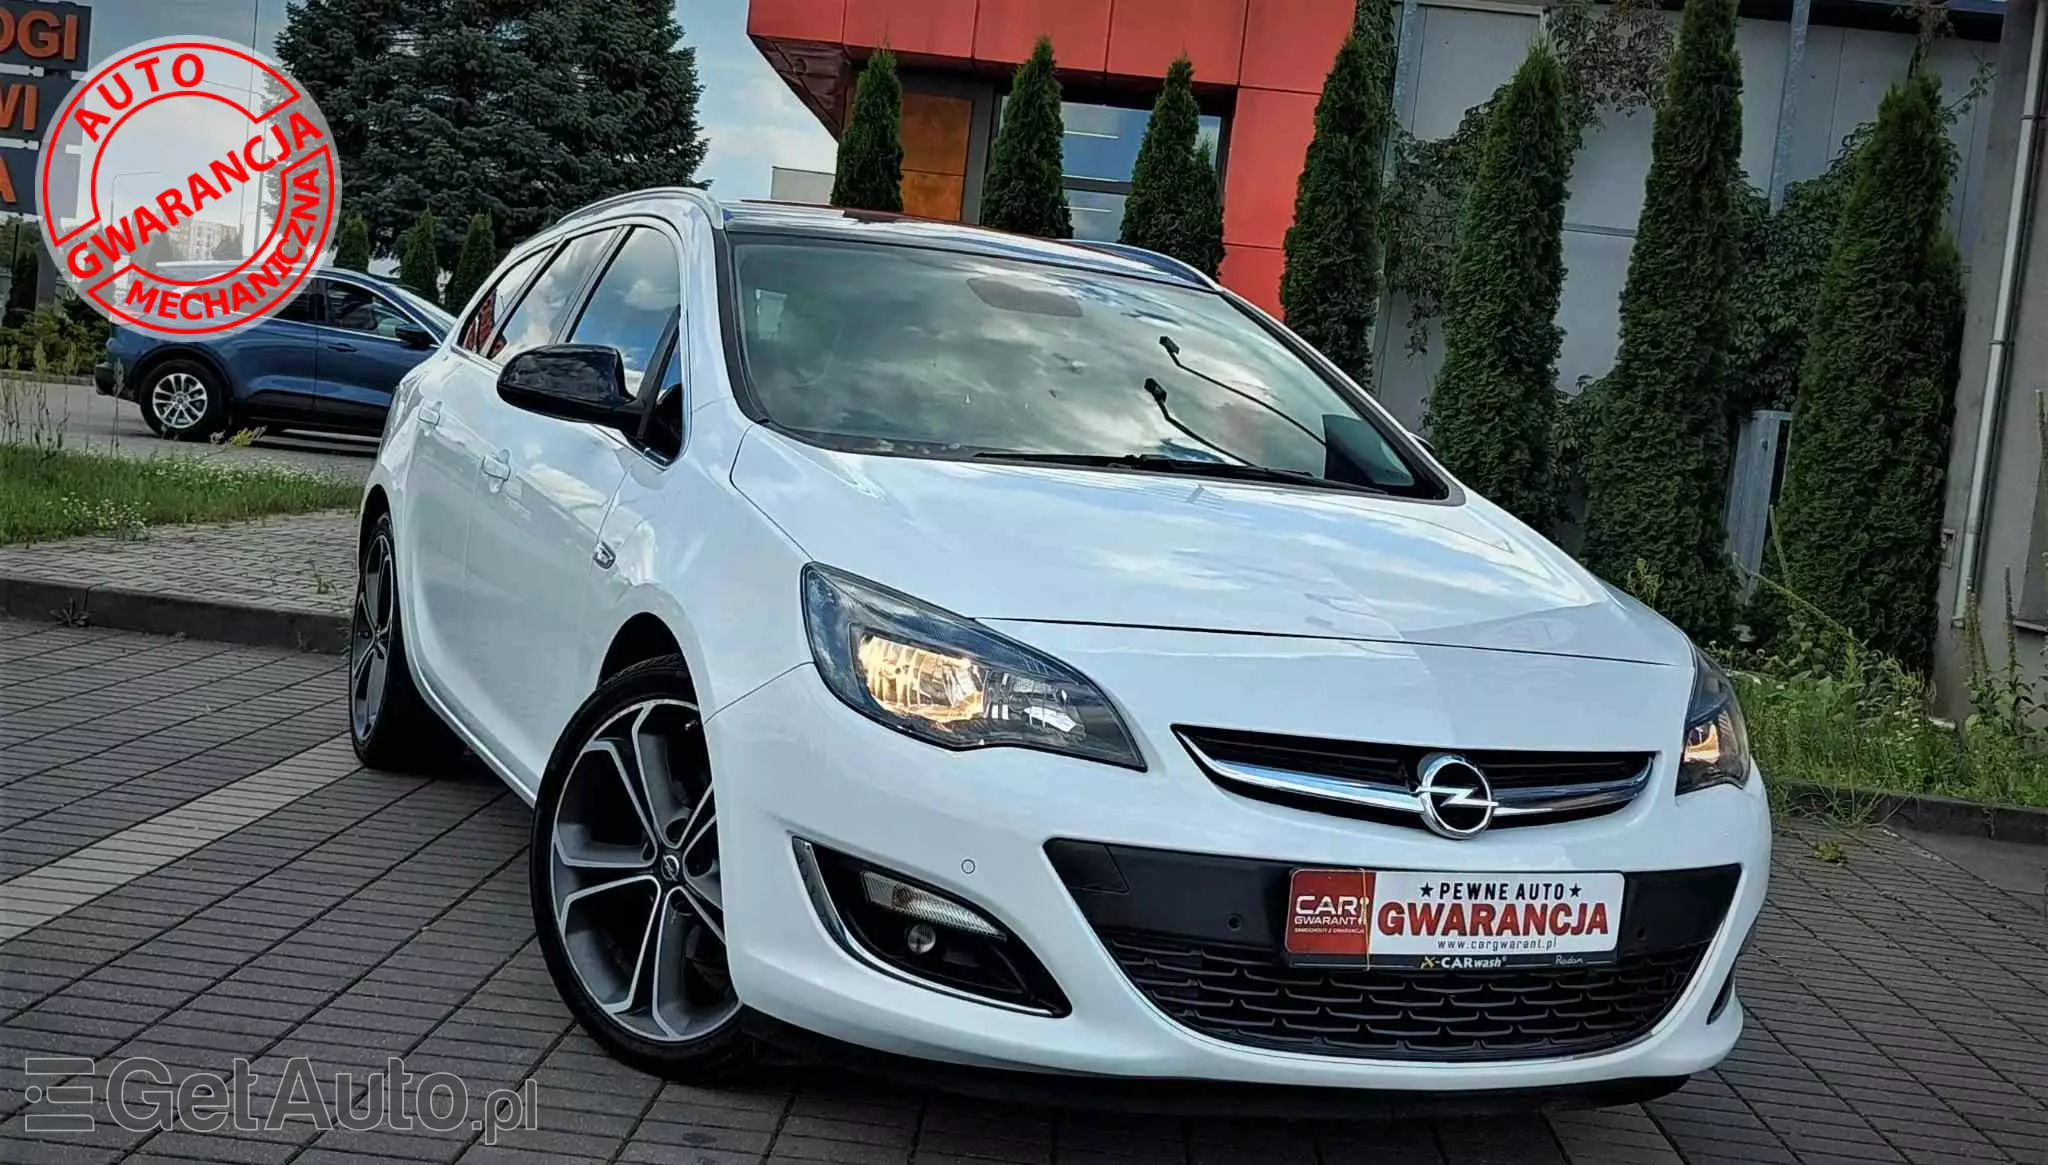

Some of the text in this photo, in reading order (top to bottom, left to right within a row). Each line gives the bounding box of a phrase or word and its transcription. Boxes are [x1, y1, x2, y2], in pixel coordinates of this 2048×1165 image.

[1439, 882, 1565, 900] PEWNE AUTO
[1294, 916, 1357, 925] GWARANT
[1377, 902, 1609, 936] GWARANCJA
[1437, 937, 1557, 951] www.cargwarant.pl
